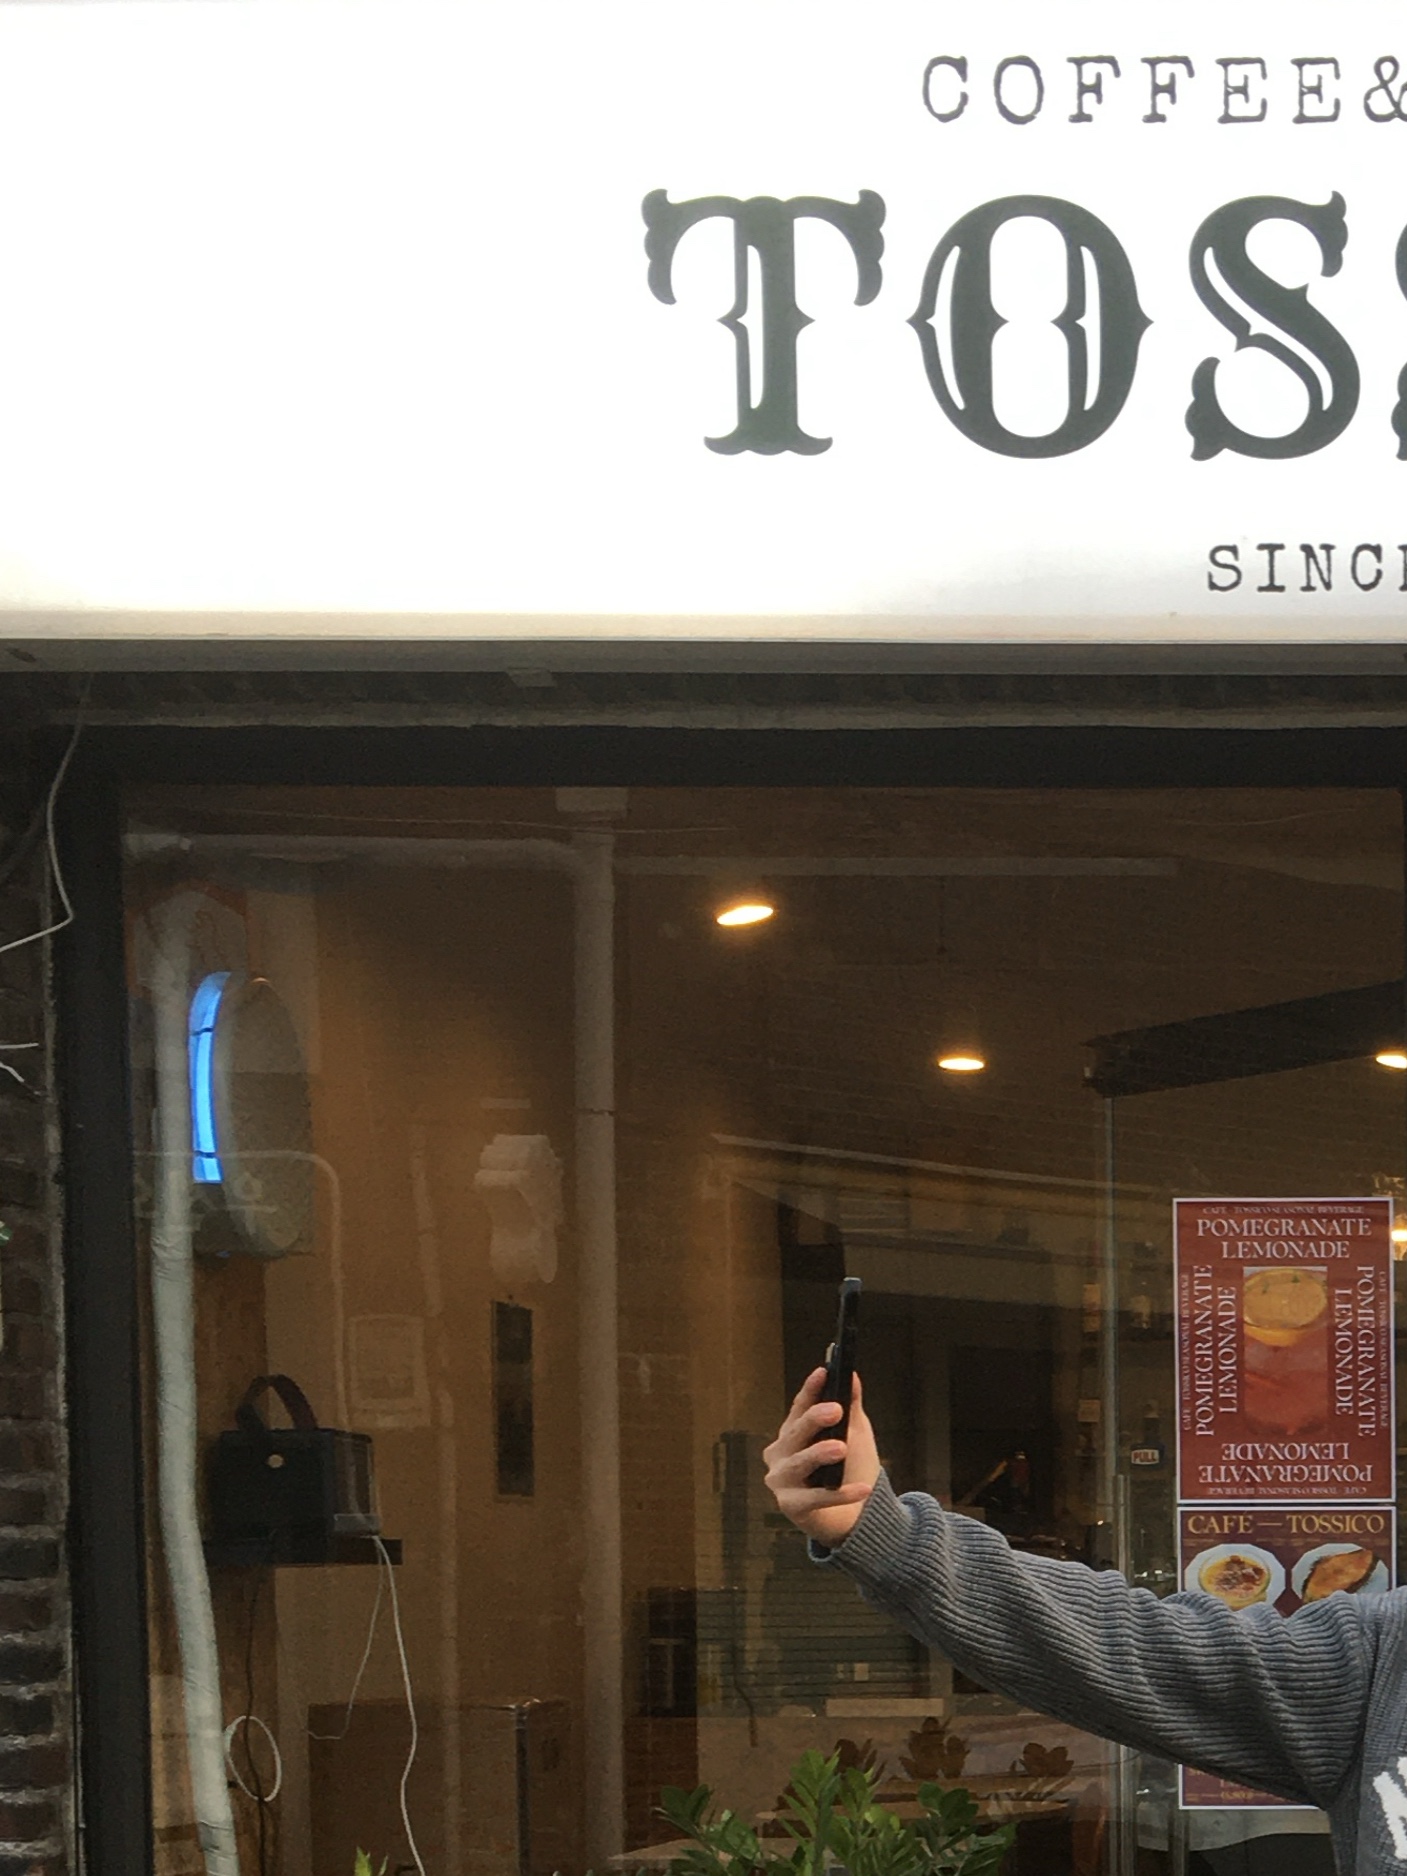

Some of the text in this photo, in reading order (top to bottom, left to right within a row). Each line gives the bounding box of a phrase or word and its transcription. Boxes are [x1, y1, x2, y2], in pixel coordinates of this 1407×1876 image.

[1197, 1218, 1372, 1237] POMEGRANATE
[1222, 1240, 1350, 1259] LEMONADE
[1193, 1264, 1214, 1436] POMEGRANATE
[1217, 1286, 1237, 1412] LEMONADE
[1335, 1288, 1353, 1415] LEMONADE
[1357, 1265, 1376, 1437] POMEGRANATE
[1133, 1451, 1156, 1463] PULL
[1221, 1442, 1349, 1461] LEMONADE
[1198, 1464, 1372, 1483] POMEGRANATE
[1286, 1514, 1385, 1534] TOSSICO
